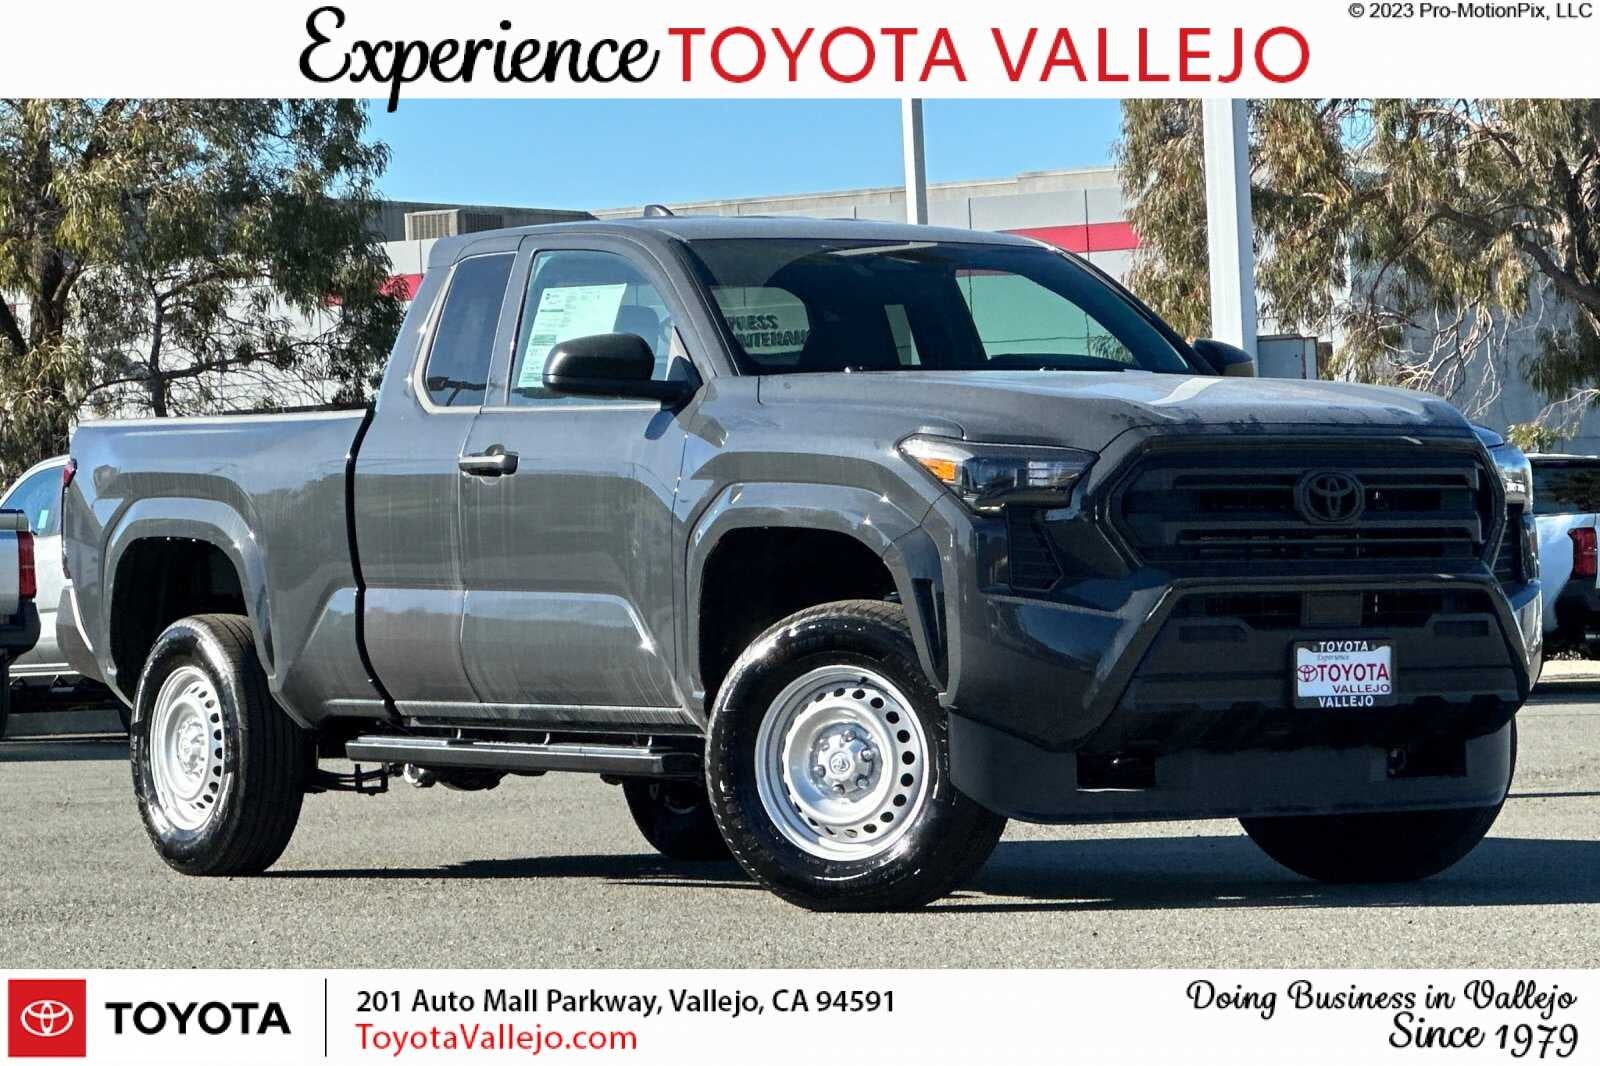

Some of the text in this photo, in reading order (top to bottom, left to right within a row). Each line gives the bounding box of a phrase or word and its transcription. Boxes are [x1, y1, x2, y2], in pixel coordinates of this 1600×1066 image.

[1319, 641, 1368, 652] TOYOTA
[1317, 663, 1389, 682] TOYOTA
[1332, 684, 1390, 693] VALLEJO
[1319, 695, 1374, 707] VALLEJO
